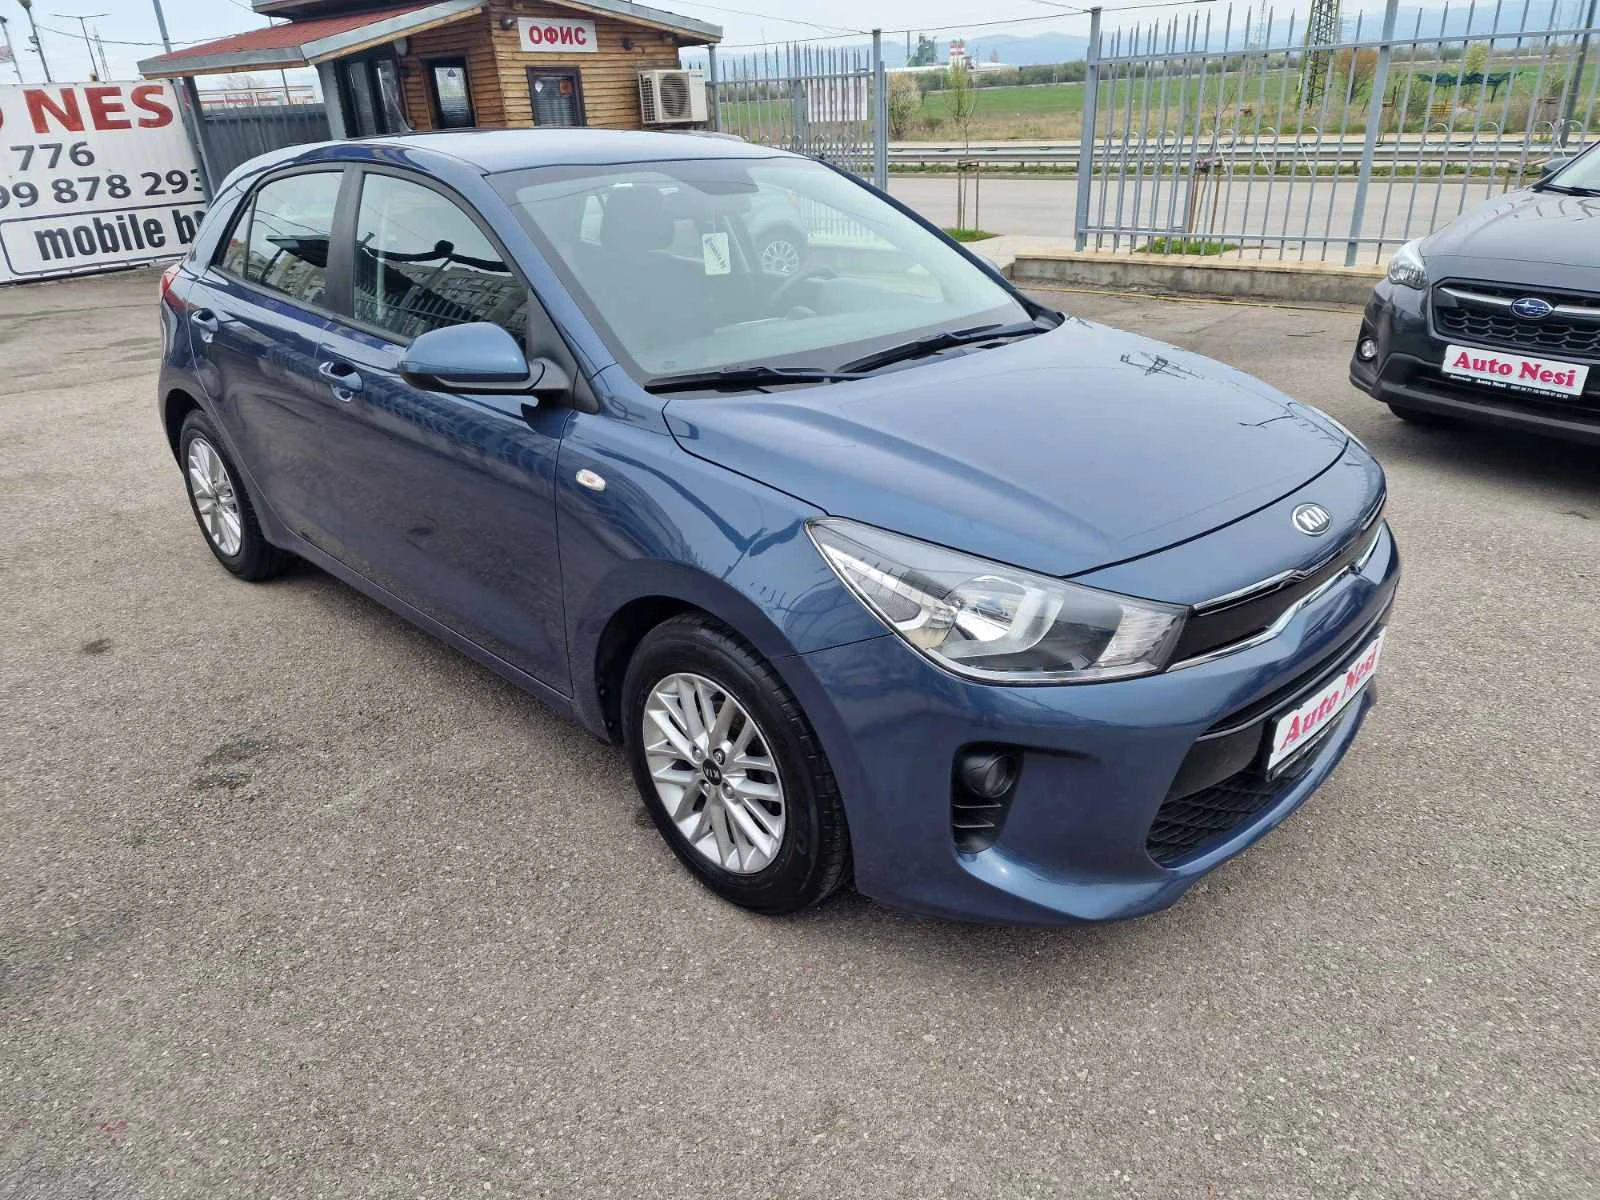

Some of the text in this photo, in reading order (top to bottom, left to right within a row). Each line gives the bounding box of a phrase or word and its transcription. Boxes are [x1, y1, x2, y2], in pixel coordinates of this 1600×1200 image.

[529, 25, 586, 45] ОФИС
[10, 141, 95, 171] 776
[51, 174, 131, 204] 878
[34, 213, 166, 261] mobile
[1453, 351, 1513, 376] Auto
[1518, 361, 1577, 387] Nesi
[1297, 506, 1330, 530] KIA
[1280, 690, 1339, 751] Auto
[1343, 642, 1378, 697] Nesi
